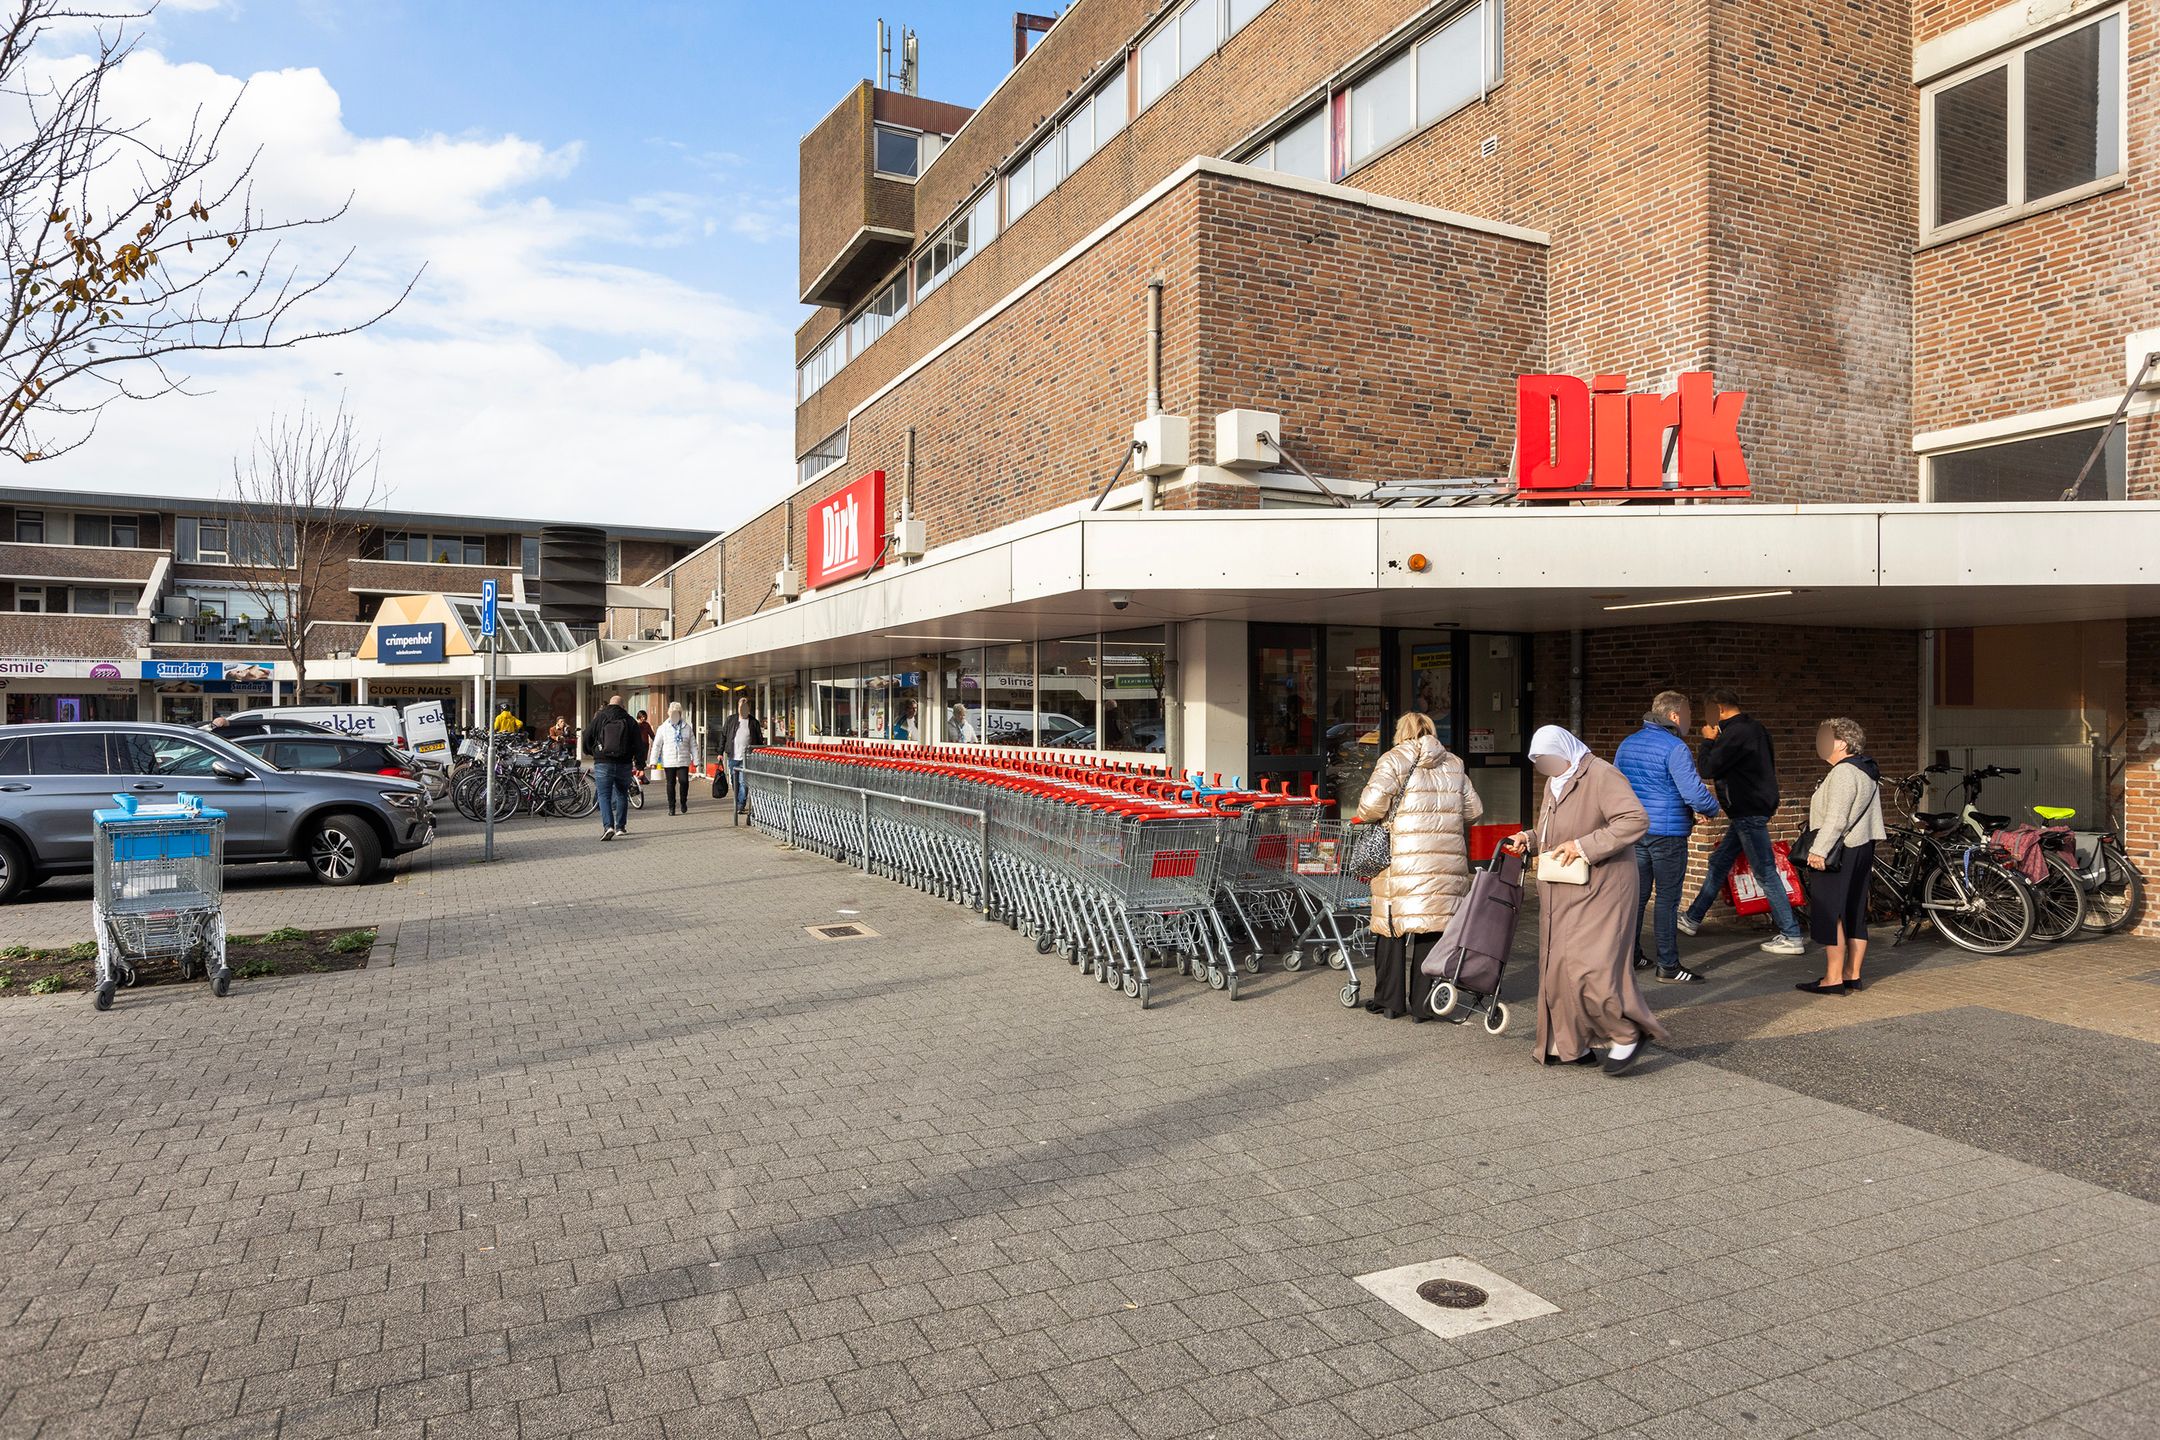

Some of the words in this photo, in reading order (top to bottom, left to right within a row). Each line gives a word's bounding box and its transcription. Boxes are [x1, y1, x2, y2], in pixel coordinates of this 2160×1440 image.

[1516, 371, 1750, 489] Dirk
[822, 493, 859, 570] Dirk
[485, 584, 492, 611] P
[385, 631, 432, 648] crimpenhof
[0, 662, 46, 673] smile
[157, 663, 208, 675] Sunday's
[231, 682, 266, 692] Sunday's
[370, 686, 415, 695] CLOVER
[417, 686, 452, 695] NAILS
[312, 714, 376, 731] eklet
